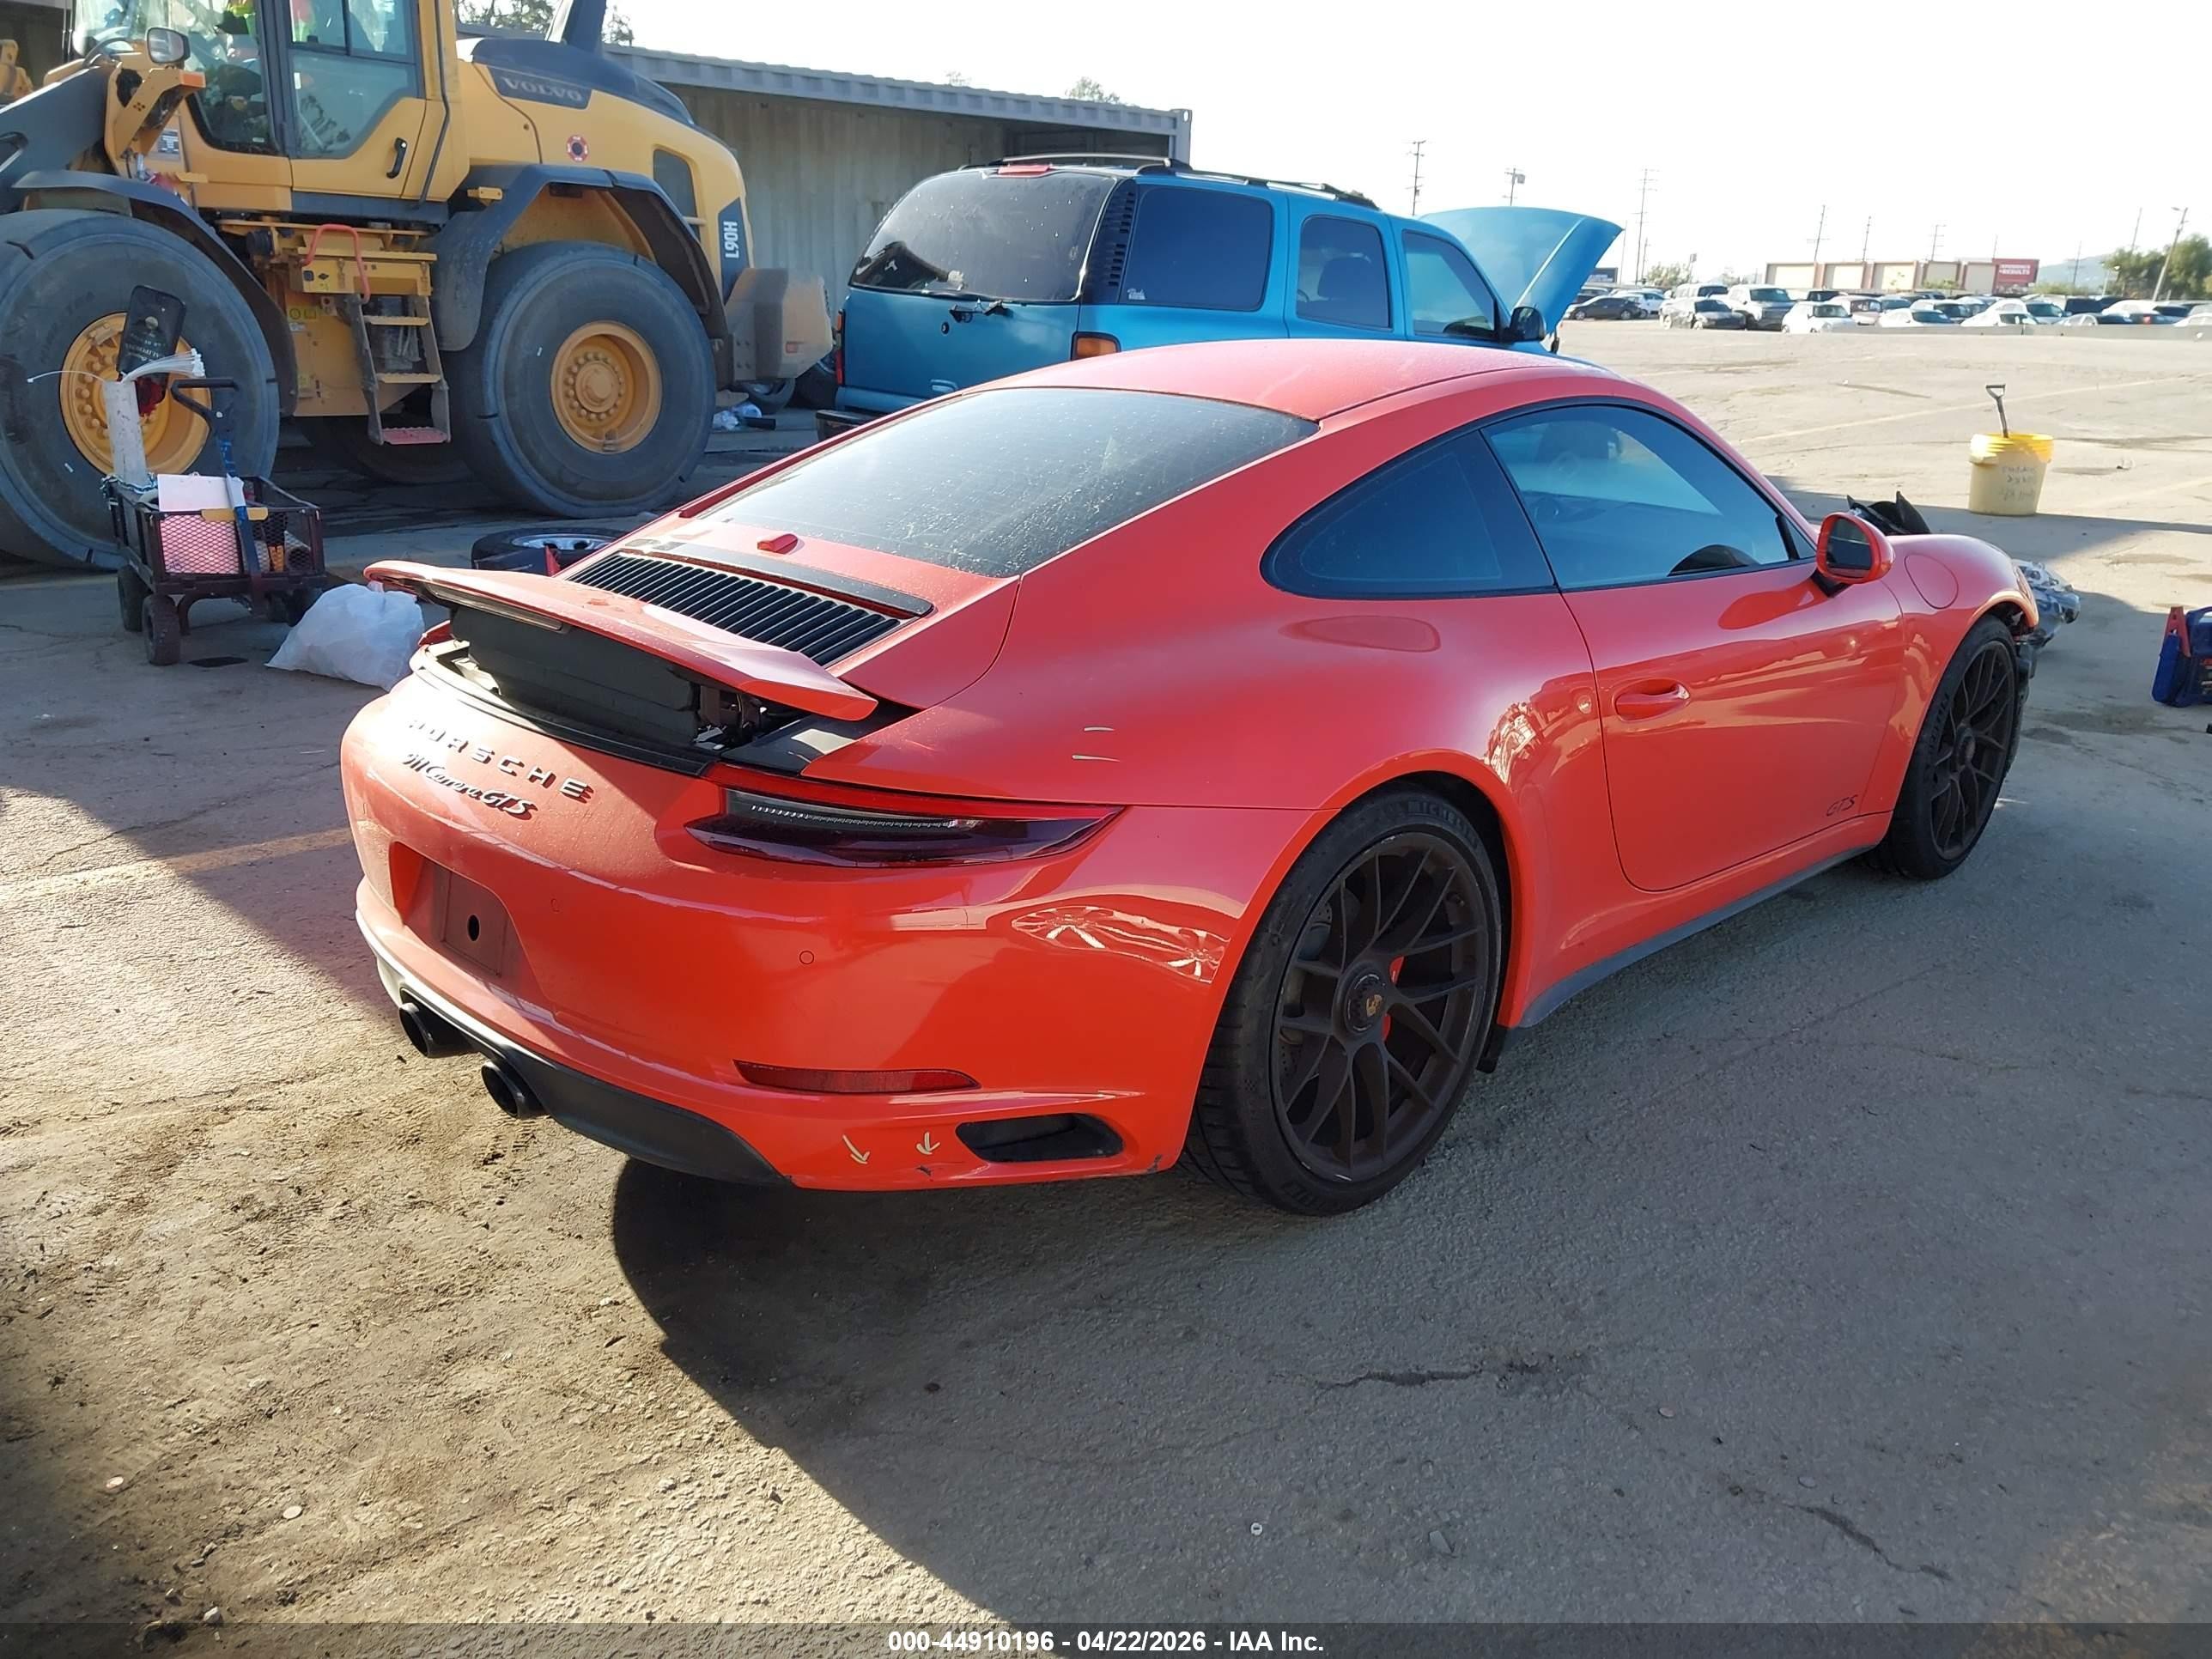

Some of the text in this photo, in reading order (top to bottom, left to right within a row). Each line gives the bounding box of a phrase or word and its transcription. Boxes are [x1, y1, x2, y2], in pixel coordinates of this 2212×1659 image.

[501, 76, 582, 101] VOLVO
[722, 220, 740, 259] L90H
[409, 720, 592, 801] PORSCHE
[1826, 794, 1858, 817] GTS
